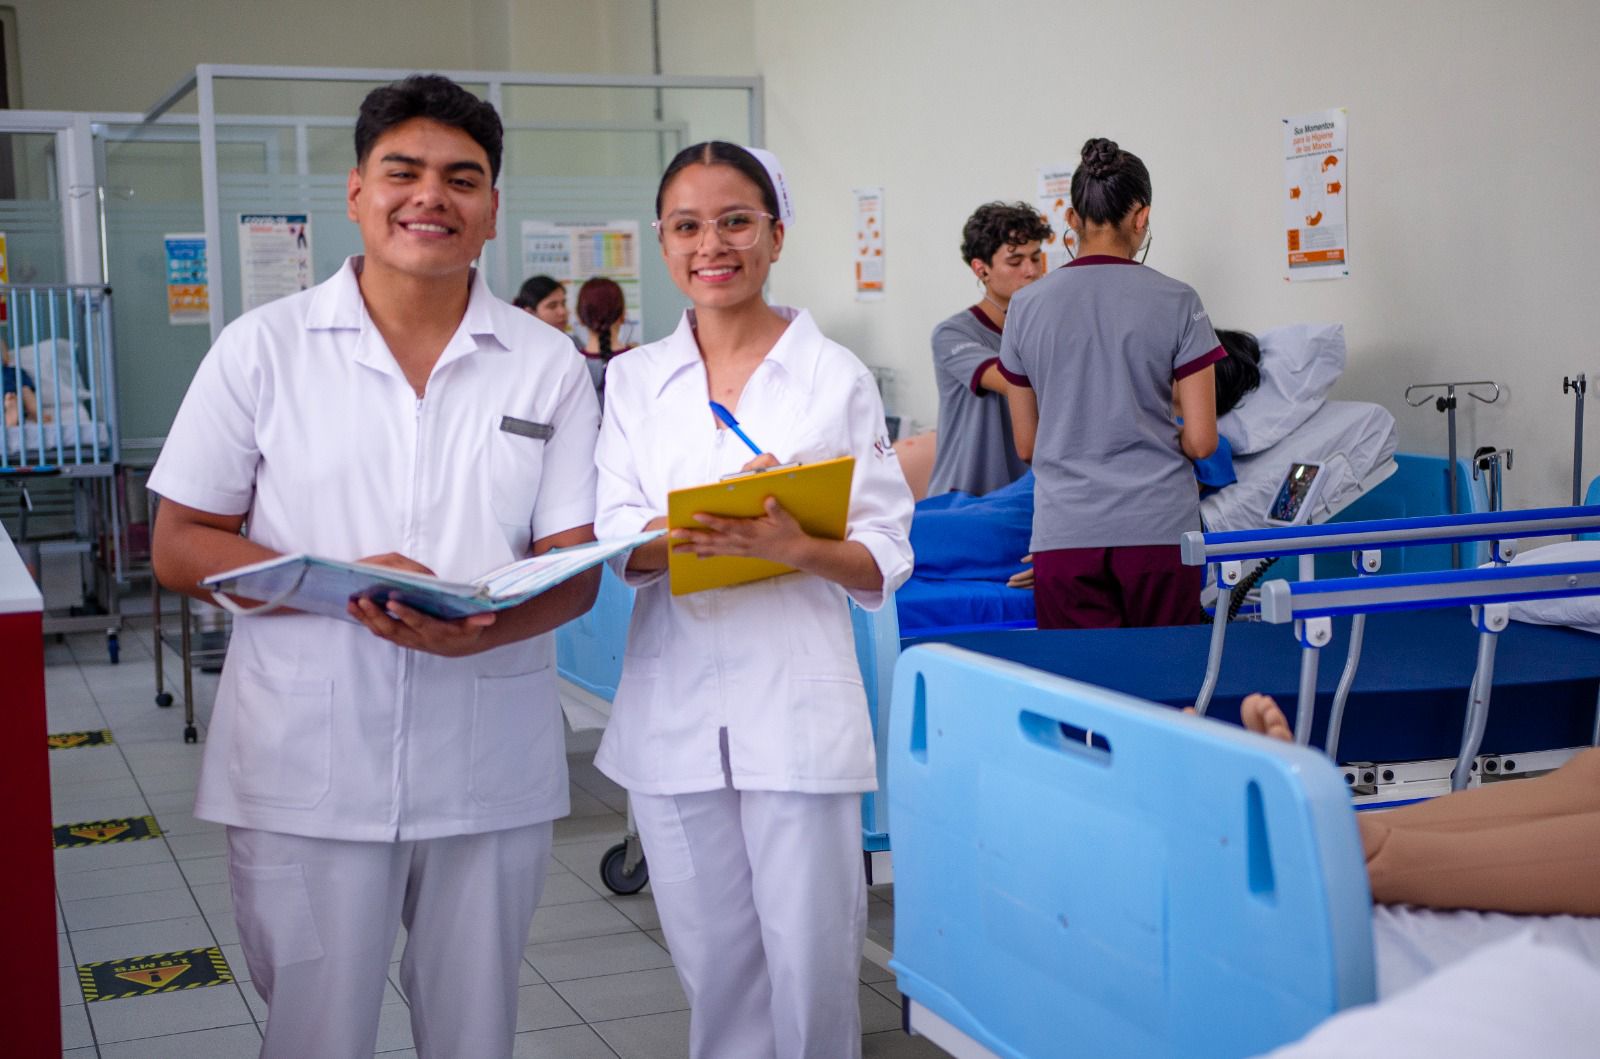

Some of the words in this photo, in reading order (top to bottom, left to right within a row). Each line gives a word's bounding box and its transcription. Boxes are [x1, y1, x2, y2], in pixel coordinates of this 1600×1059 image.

[1304, 121, 1335, 133] Momentos
[1312, 141, 1332, 151] Manos
[113, 962, 156, 973] MTS
